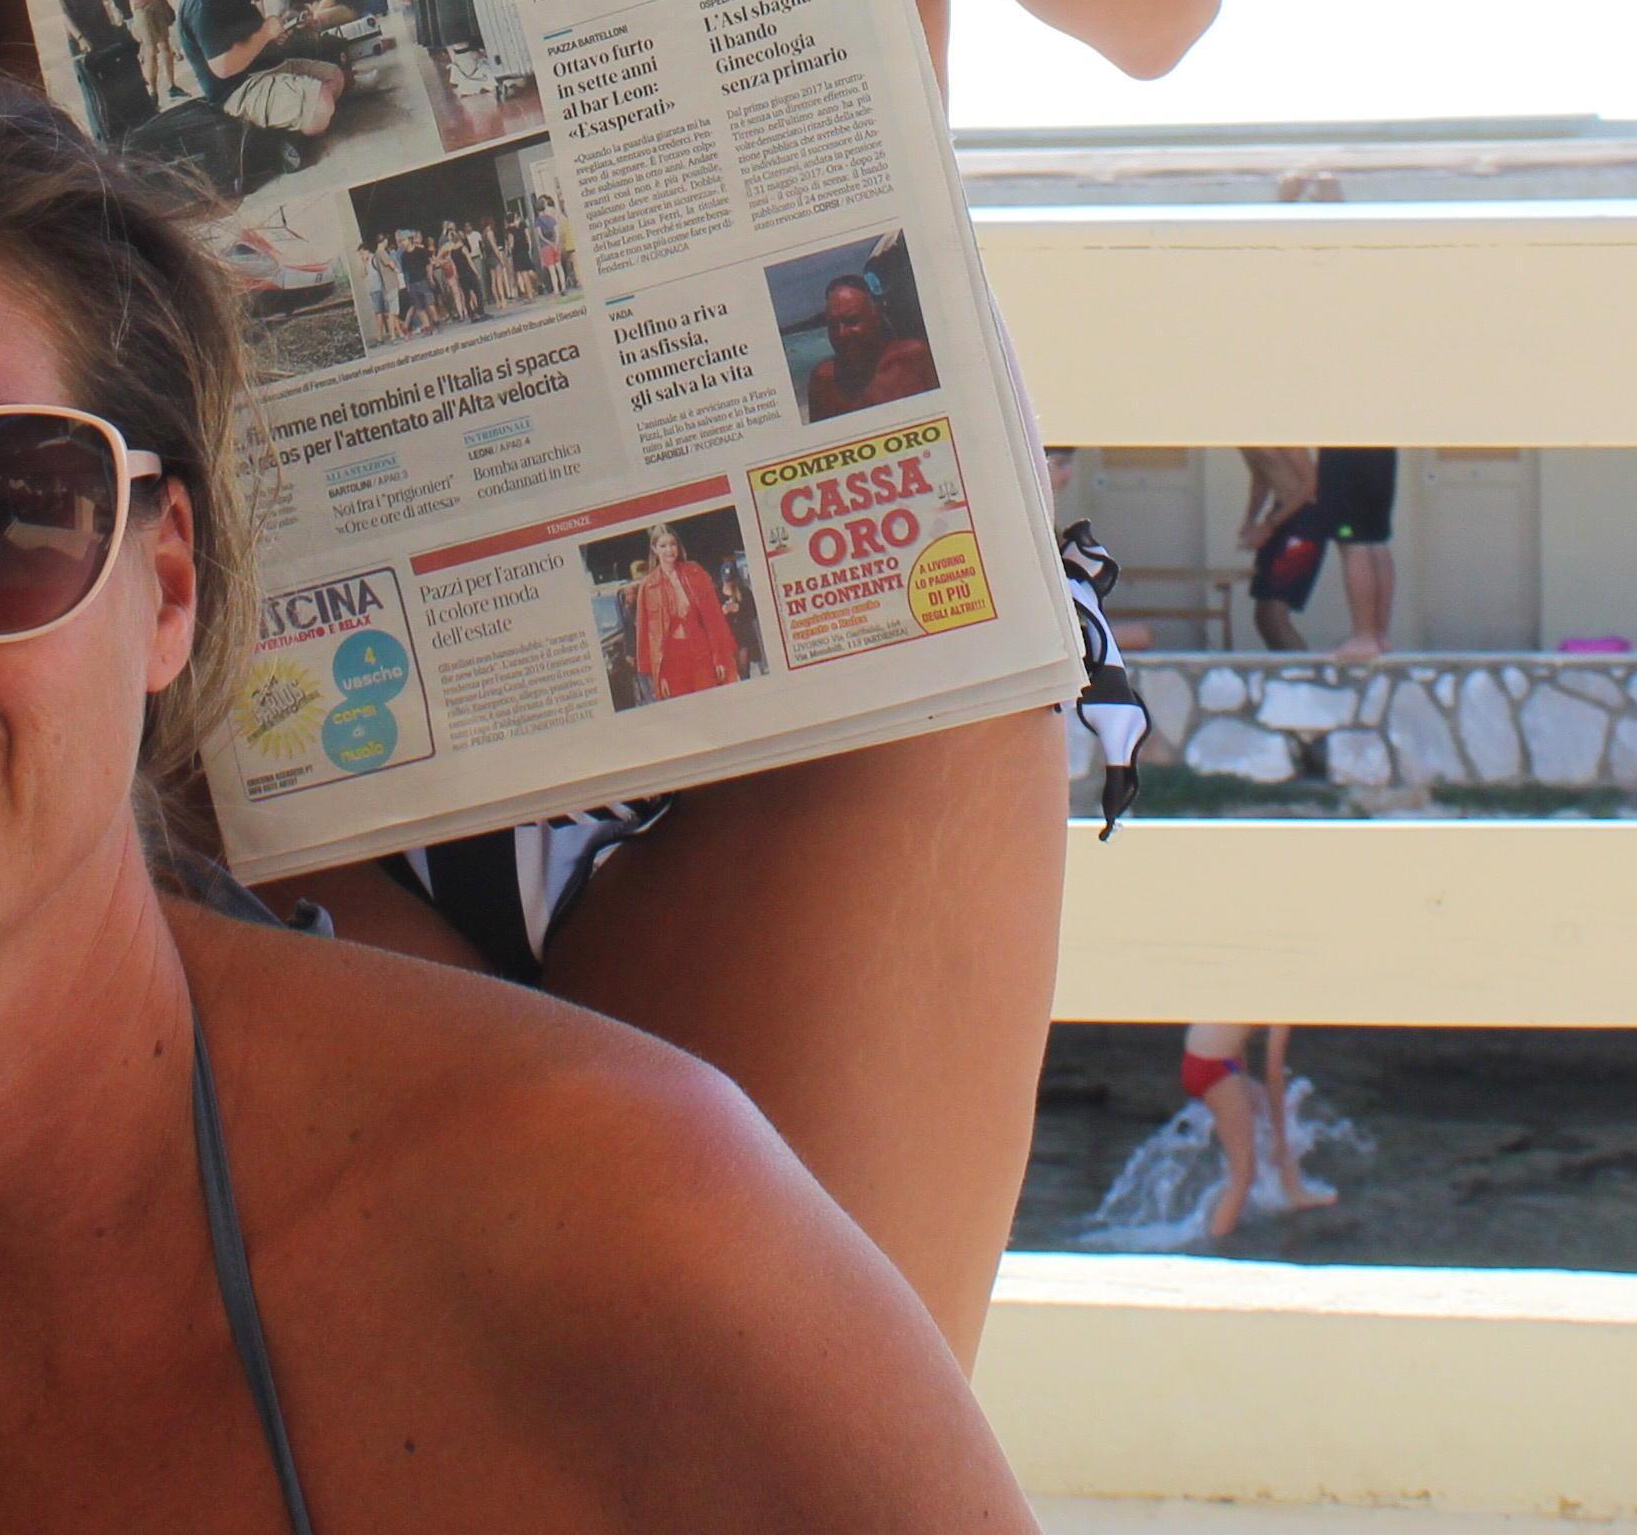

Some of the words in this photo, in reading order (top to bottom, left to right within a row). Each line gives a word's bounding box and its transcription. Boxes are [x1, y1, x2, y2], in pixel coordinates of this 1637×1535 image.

[703, 5, 749, 33] L'Asl
[709, 36, 723, 54] il
[723, 22, 778, 50] bando
[547, 39, 579, 56] PIAZZA
[577, 25, 628, 48] BARTELLONI
[552, 52, 610, 78] Ottavo
[612, 39, 654, 61] furto
[715, 33, 816, 74] Ginecologia
[557, 84, 575, 100] in
[577, 72, 618, 93] sette
[621, 55, 658, 81] anni
[721, 72, 770, 95] senza
[772, 47, 848, 85] primario
[562, 102, 579, 121] al
[579, 96, 609, 115] bar
[611, 82, 659, 106] Leon:
[568, 98, 676, 139] «Esasperati»
[609, 308, 633, 322] VADA
[613, 318, 678, 345] Delfino
[693, 304, 728, 323] riva
[618, 350, 637, 366] in
[640, 331, 709, 361] asfissia,
[625, 344, 748, 387] commerciante
[319, 403, 348, 428] nei
[349, 382, 422, 420] tombini
[423, 384, 436, 400] e
[436, 365, 494, 396] l'Italia
[495, 357, 513, 380] si
[514, 344, 581, 377] spacca
[630, 388, 653, 412] gli
[655, 380, 699, 401] salva
[700, 373, 718, 390] la
[720, 365, 754, 383] vita
[302, 438, 332, 464] per
[334, 413, 430, 451] l'attentato
[431, 394, 496, 425] all'Alta
[497, 371, 570, 406] velocità
[468, 446, 494, 461] LEONI
[472, 459, 519, 482] Bomba
[519, 443, 582, 469] anarchica
[759, 443, 877, 487] COMPRO
[883, 426, 941, 454] ORO
[328, 479, 373, 499] BARTOLINI
[477, 468, 548, 499] condannati
[548, 467, 562, 481] in
[562, 463, 581, 477] tre
[779, 452, 934, 528] CASSA
[332, 501, 356, 519] Noi
[356, 499, 375, 514] fra
[380, 511, 401, 525] ore
[402, 504, 416, 519] di
[546, 516, 592, 537] TENDENZE
[808, 508, 920, 568] ORO
[419, 577, 464, 604] Pazzi
[464, 572, 492, 597] per
[493, 553, 565, 584] l'arancio
[782, 556, 899, 598] PAGAMENTO
[914, 578, 929, 590] LO
[928, 563, 976, 587] PAGHIAMO
[927, 554, 966, 573] LIVORNO
[252, 578, 384, 640] ISCINA
[425, 608, 437, 627] il
[438, 599, 490, 623] colore
[492, 584, 540, 610] moda
[785, 597, 807, 617] IN
[811, 573, 904, 610] CONTANTI
[928, 589, 944, 607] DI
[945, 580, 971, 602] PIÙ
[431, 618, 512, 650] dell'estate
